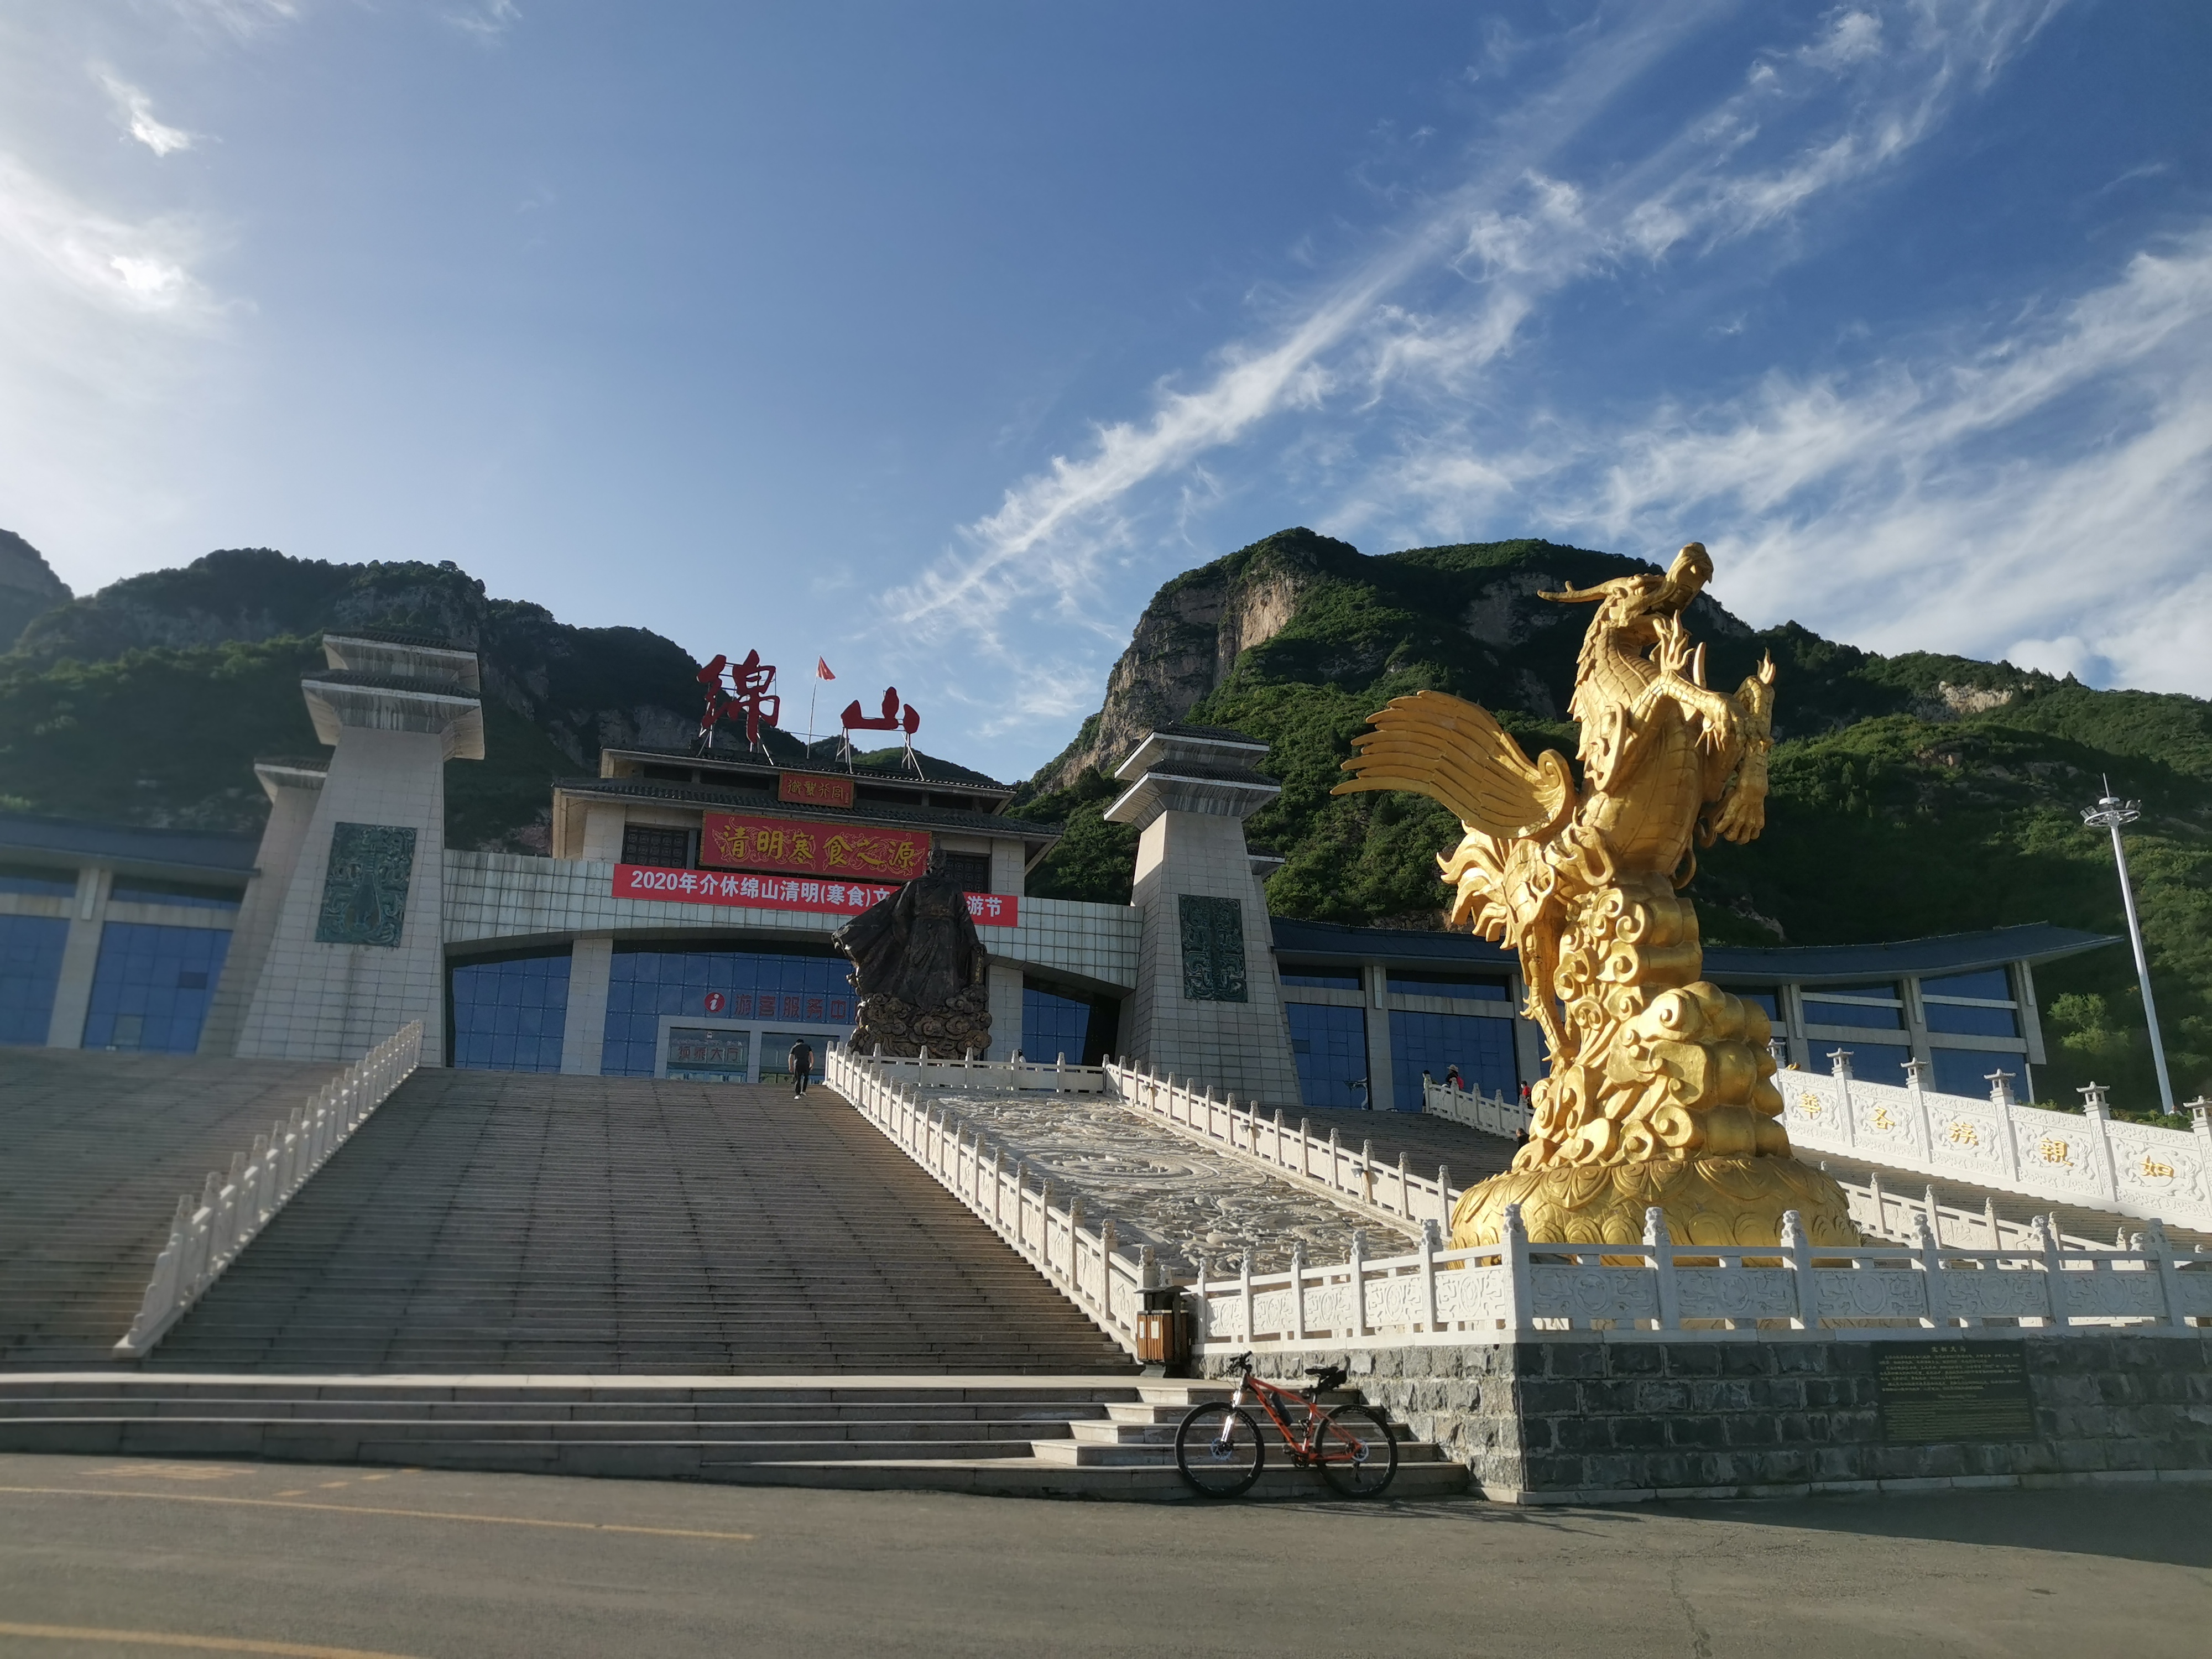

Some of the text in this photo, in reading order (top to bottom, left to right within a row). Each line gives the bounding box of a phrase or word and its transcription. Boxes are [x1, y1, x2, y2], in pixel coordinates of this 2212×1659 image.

[697, 649, 920, 743] 绵山
[721, 825, 916, 869] 清明寒食之源
[631, 870, 898, 907] 2020年介休绵山清明(寒食)文
[734, 994, 859, 1020] 游客服务中
